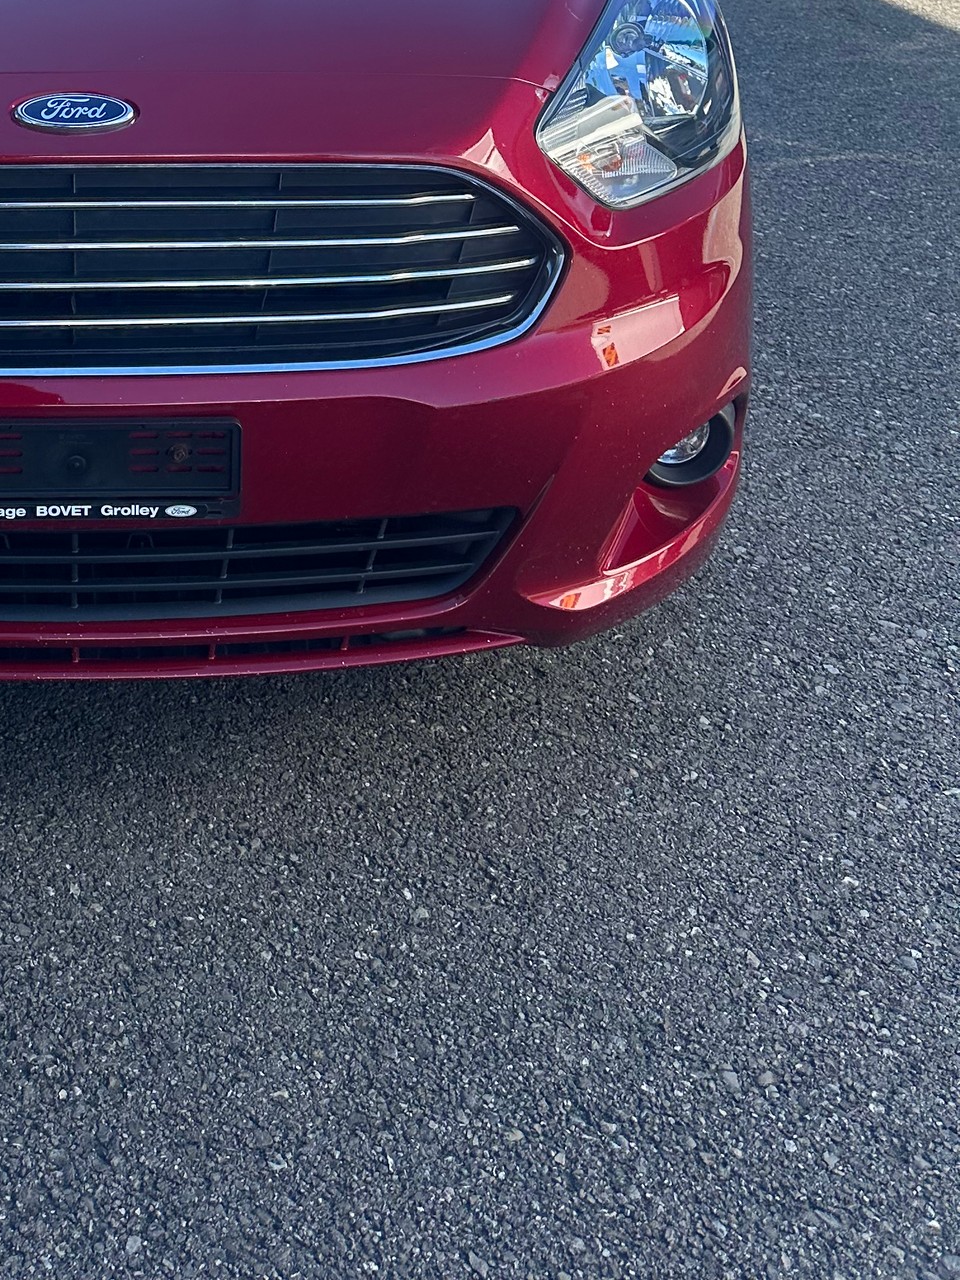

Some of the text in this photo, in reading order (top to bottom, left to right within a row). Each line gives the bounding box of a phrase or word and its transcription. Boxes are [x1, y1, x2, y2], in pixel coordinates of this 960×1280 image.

[40, 97, 107, 120] Ford
[36, 505, 92, 517] BOVET
[100, 504, 160, 518] Grolley
